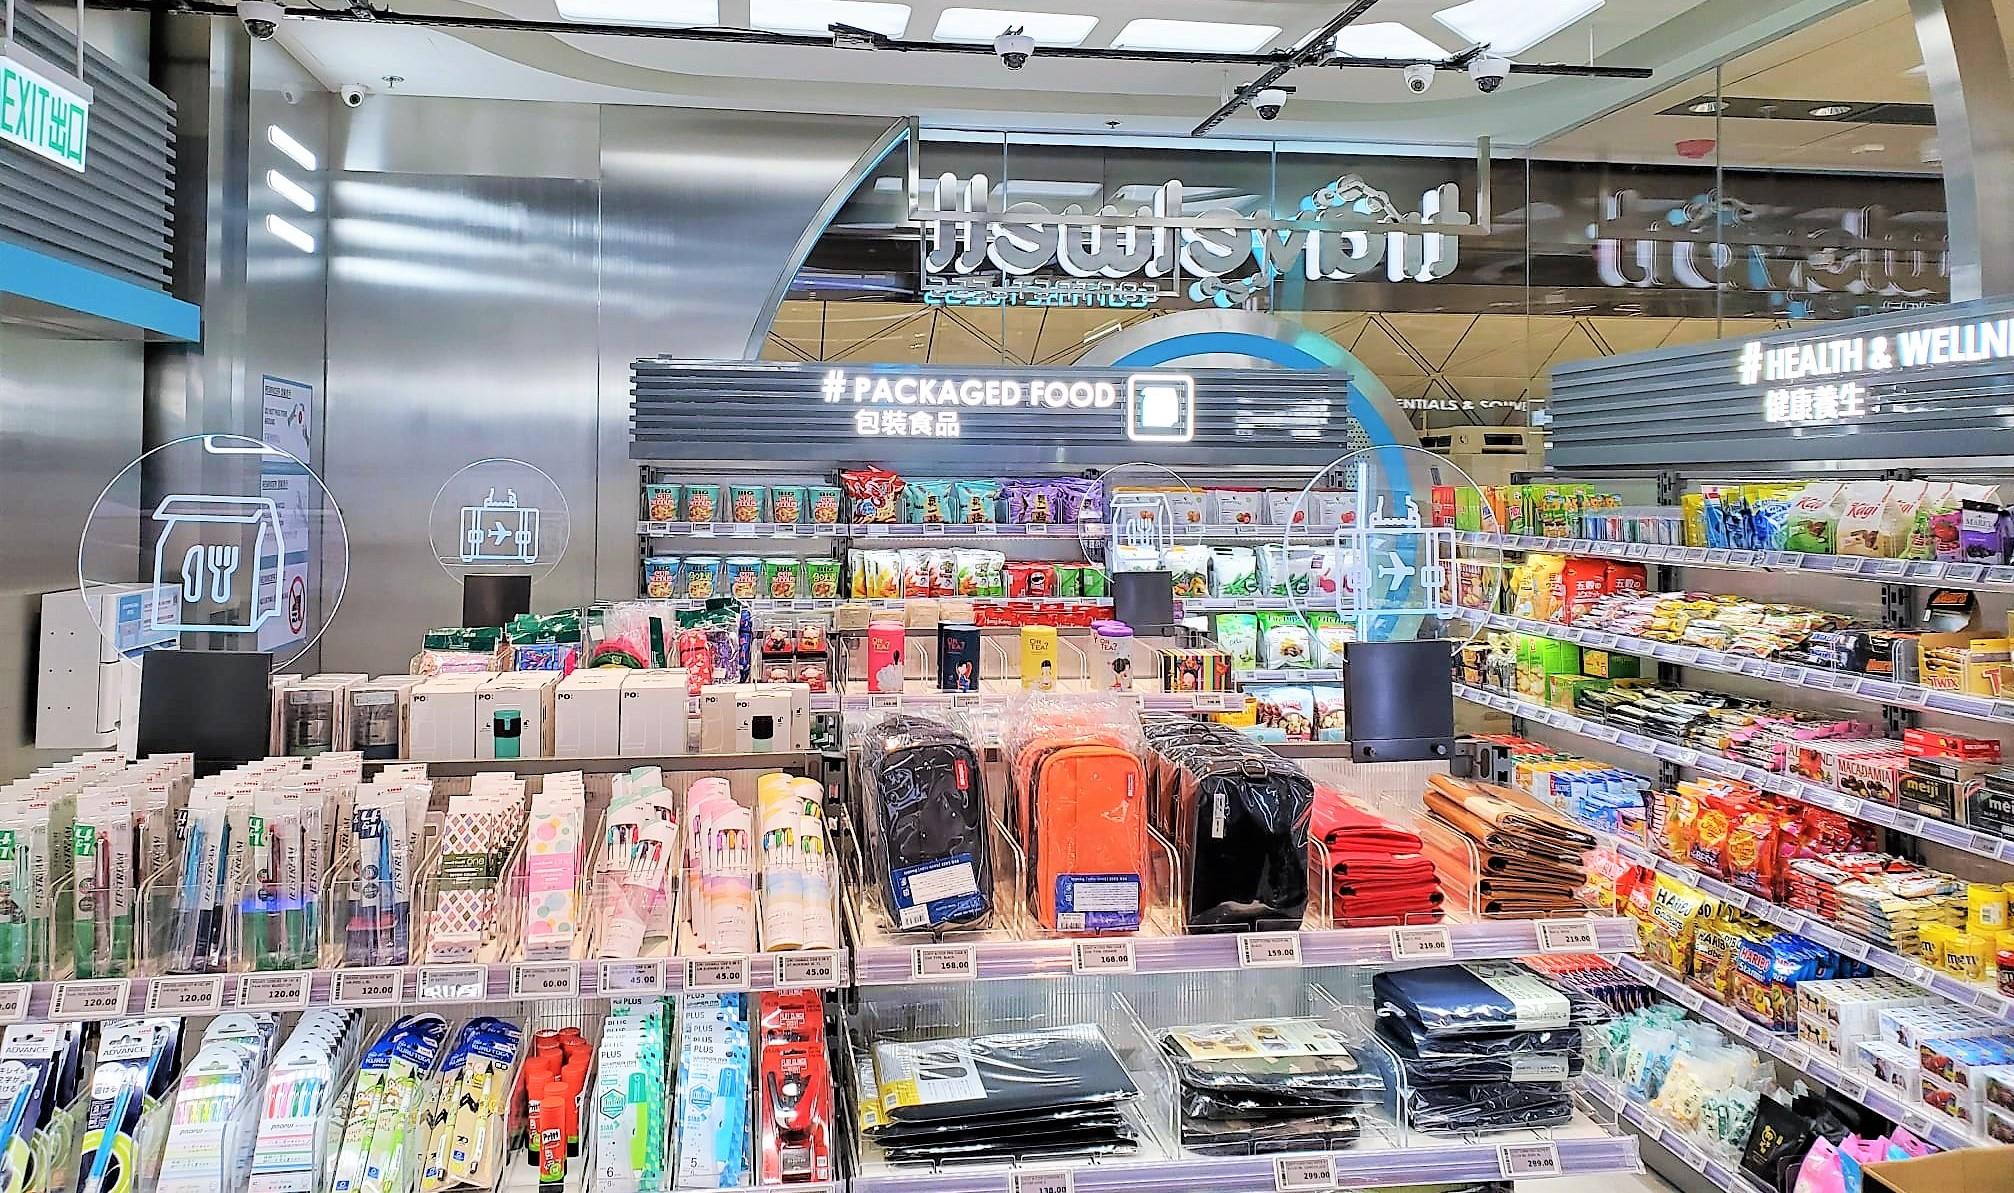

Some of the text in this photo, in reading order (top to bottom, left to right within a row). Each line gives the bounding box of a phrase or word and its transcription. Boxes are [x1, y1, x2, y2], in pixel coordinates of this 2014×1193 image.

[2, 68, 85, 165] EXIT 出口
[1738, 341, 1763, 385] #
[1765, 338, 1864, 381] HEALTH
[1867, 336, 1893, 370] &
[821, 369, 1117, 408] # PACKAGED FOOD
[1461, 400, 1474, 410] &
[855, 411, 960, 437] 包裝食品
[1847, 503, 1879, 520] Kagi
[1838, 759, 1891, 784] MACADAMIA
[1907, 777, 1939, 797] meiji
[1656, 888, 1693, 917] HARIBO
[1565, 935, 1591, 943] 219.00
[1267, 949, 1294, 957] 159.00
[1740, 946, 1770, 972] HARIBO
[716, 972, 740, 980] 45.00
[806, 968, 830, 976] 45.00
[543, 980, 568, 988] 60.00
[631, 976, 655, 984] 45.00
[269, 989, 300, 998] 120.00
[362, 986, 393, 995] 120.00
[84, 998, 118, 1007] 120.00
[179, 993, 212, 1003] 120.00
[5, 1046, 49, 1054] ADVANCE
[103, 1046, 146, 1056] ADVANCE
[694, 1045, 714, 1054] PLUS
[601, 1051, 621, 1059] PLUS
[1527, 1158, 1554, 1168] 299.00
[1303, 1171, 1330, 1180] 299.00
